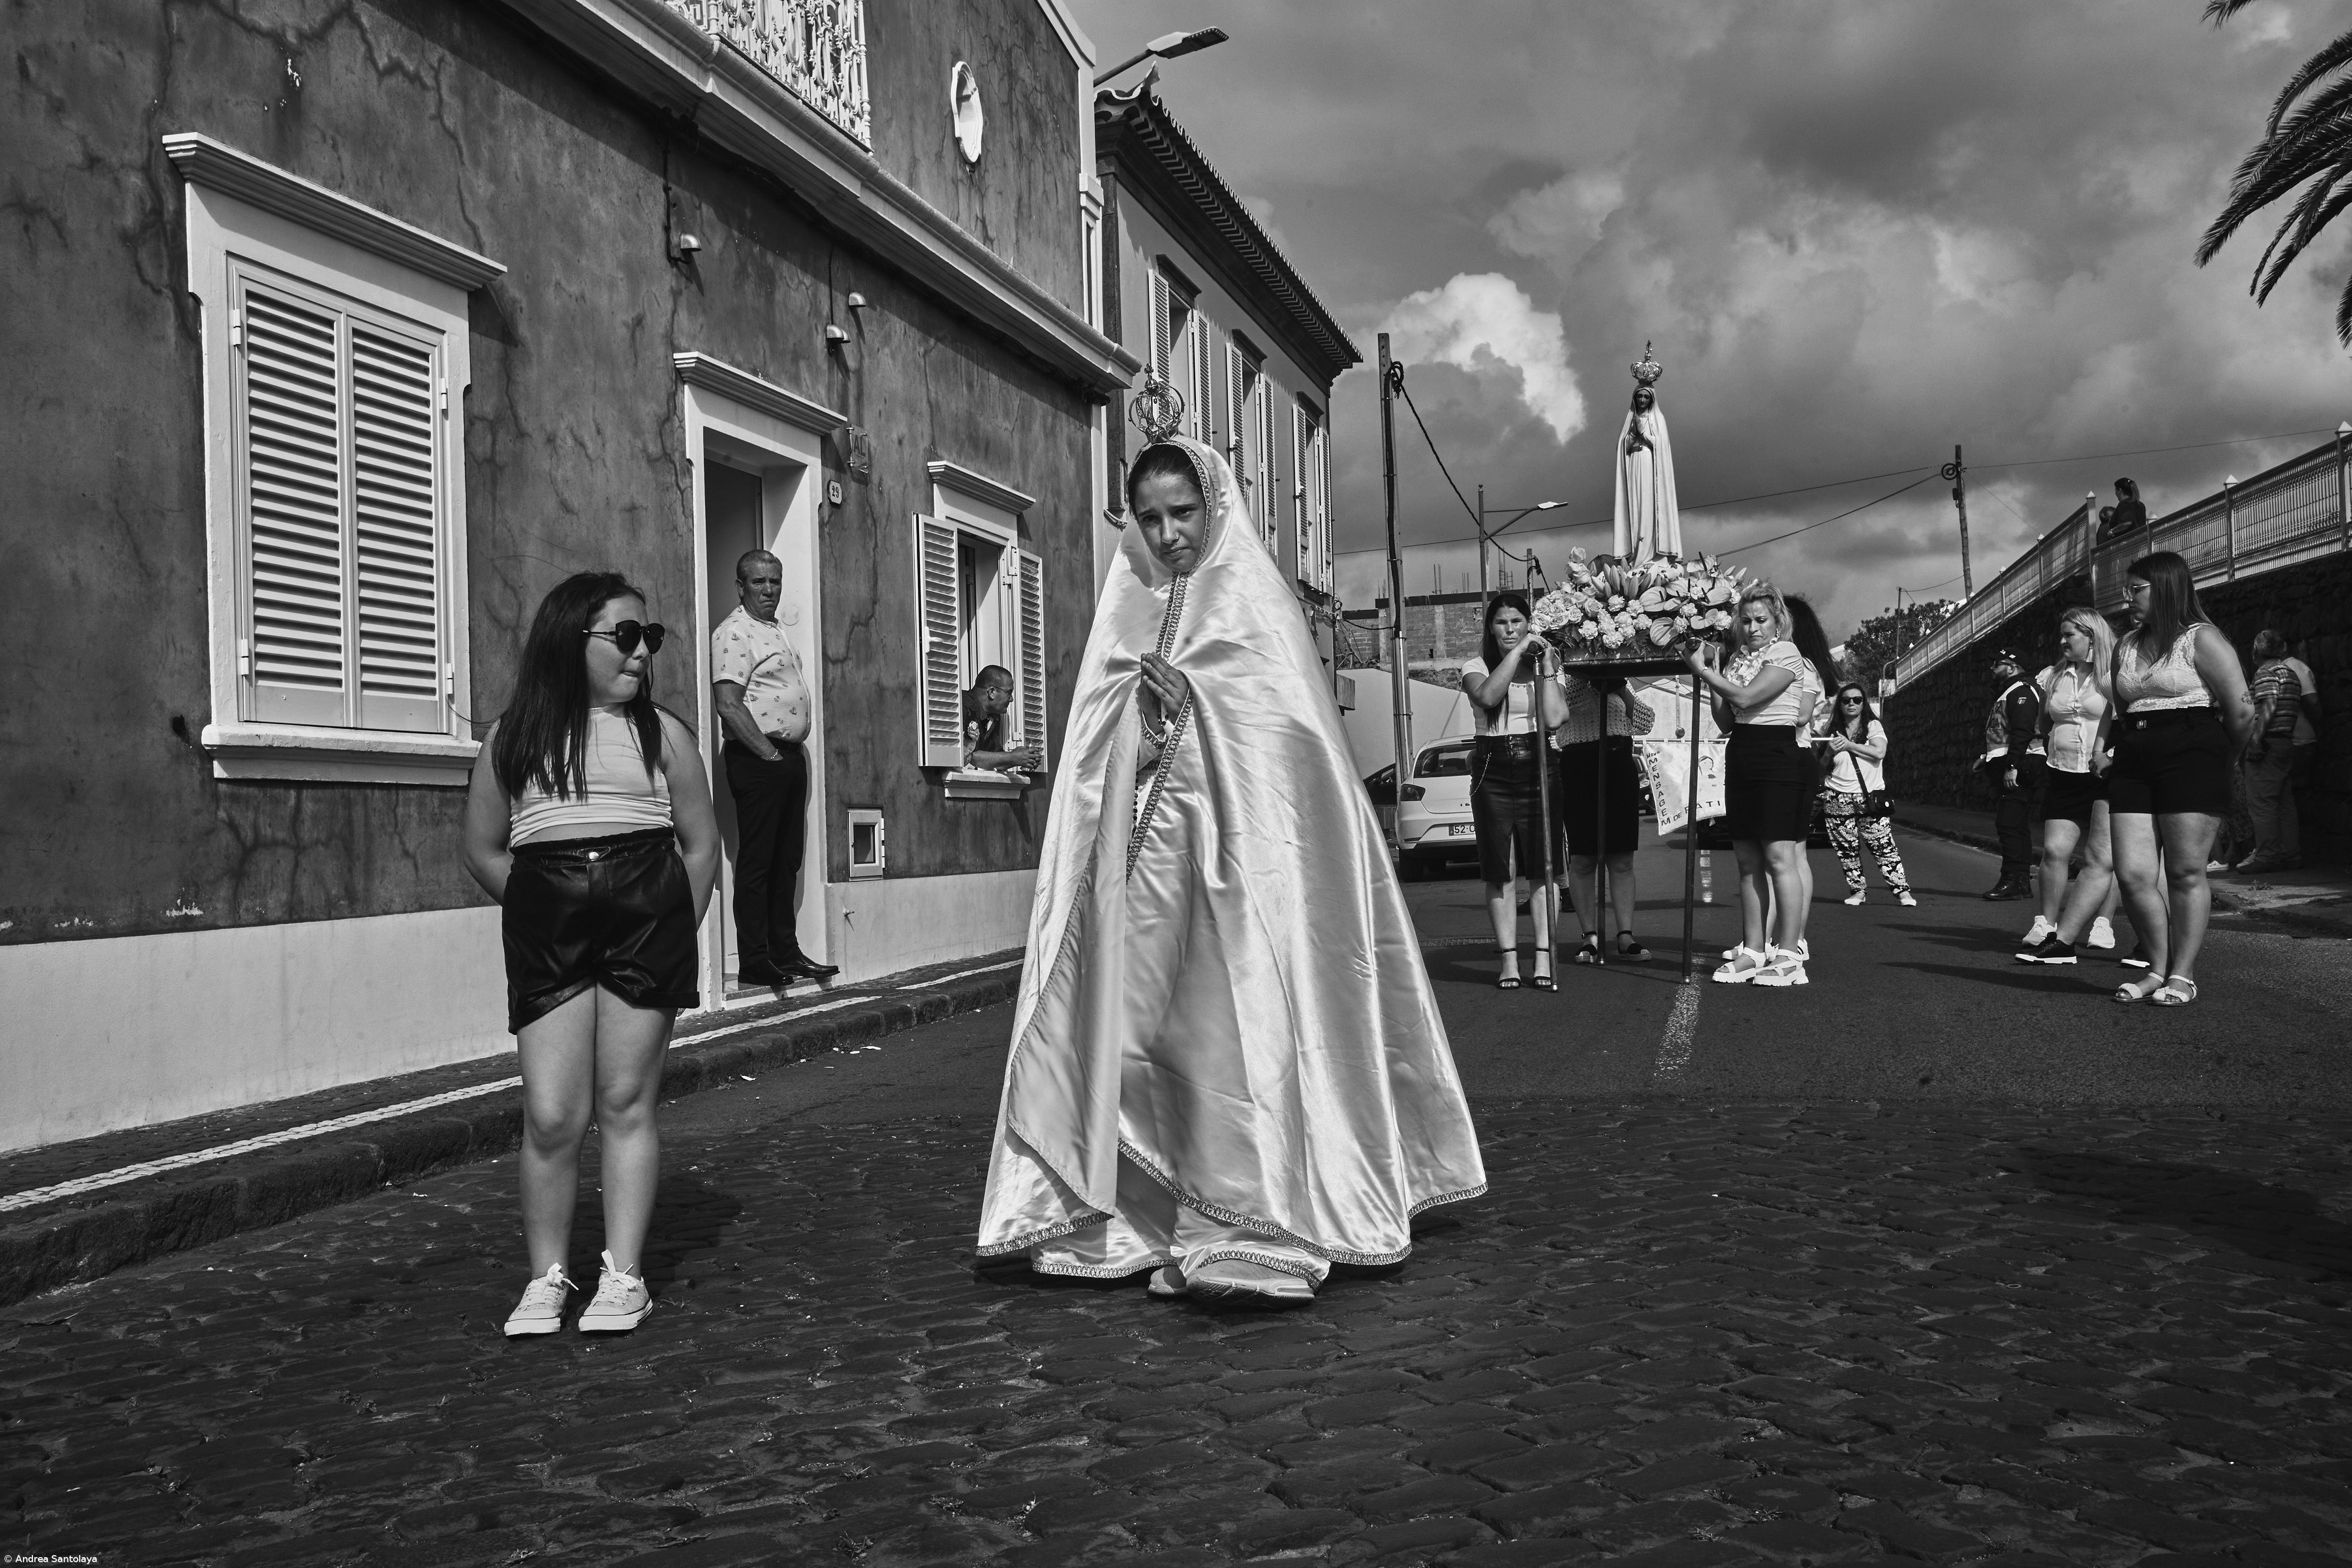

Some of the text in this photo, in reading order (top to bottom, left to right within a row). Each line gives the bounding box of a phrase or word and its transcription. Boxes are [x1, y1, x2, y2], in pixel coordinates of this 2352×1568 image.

[853, 435, 866, 457] AL
[832, 485, 839, 498] 29
[1648, 757, 1671, 826] MENSAGEM
[1673, 812, 1682, 821] DE
